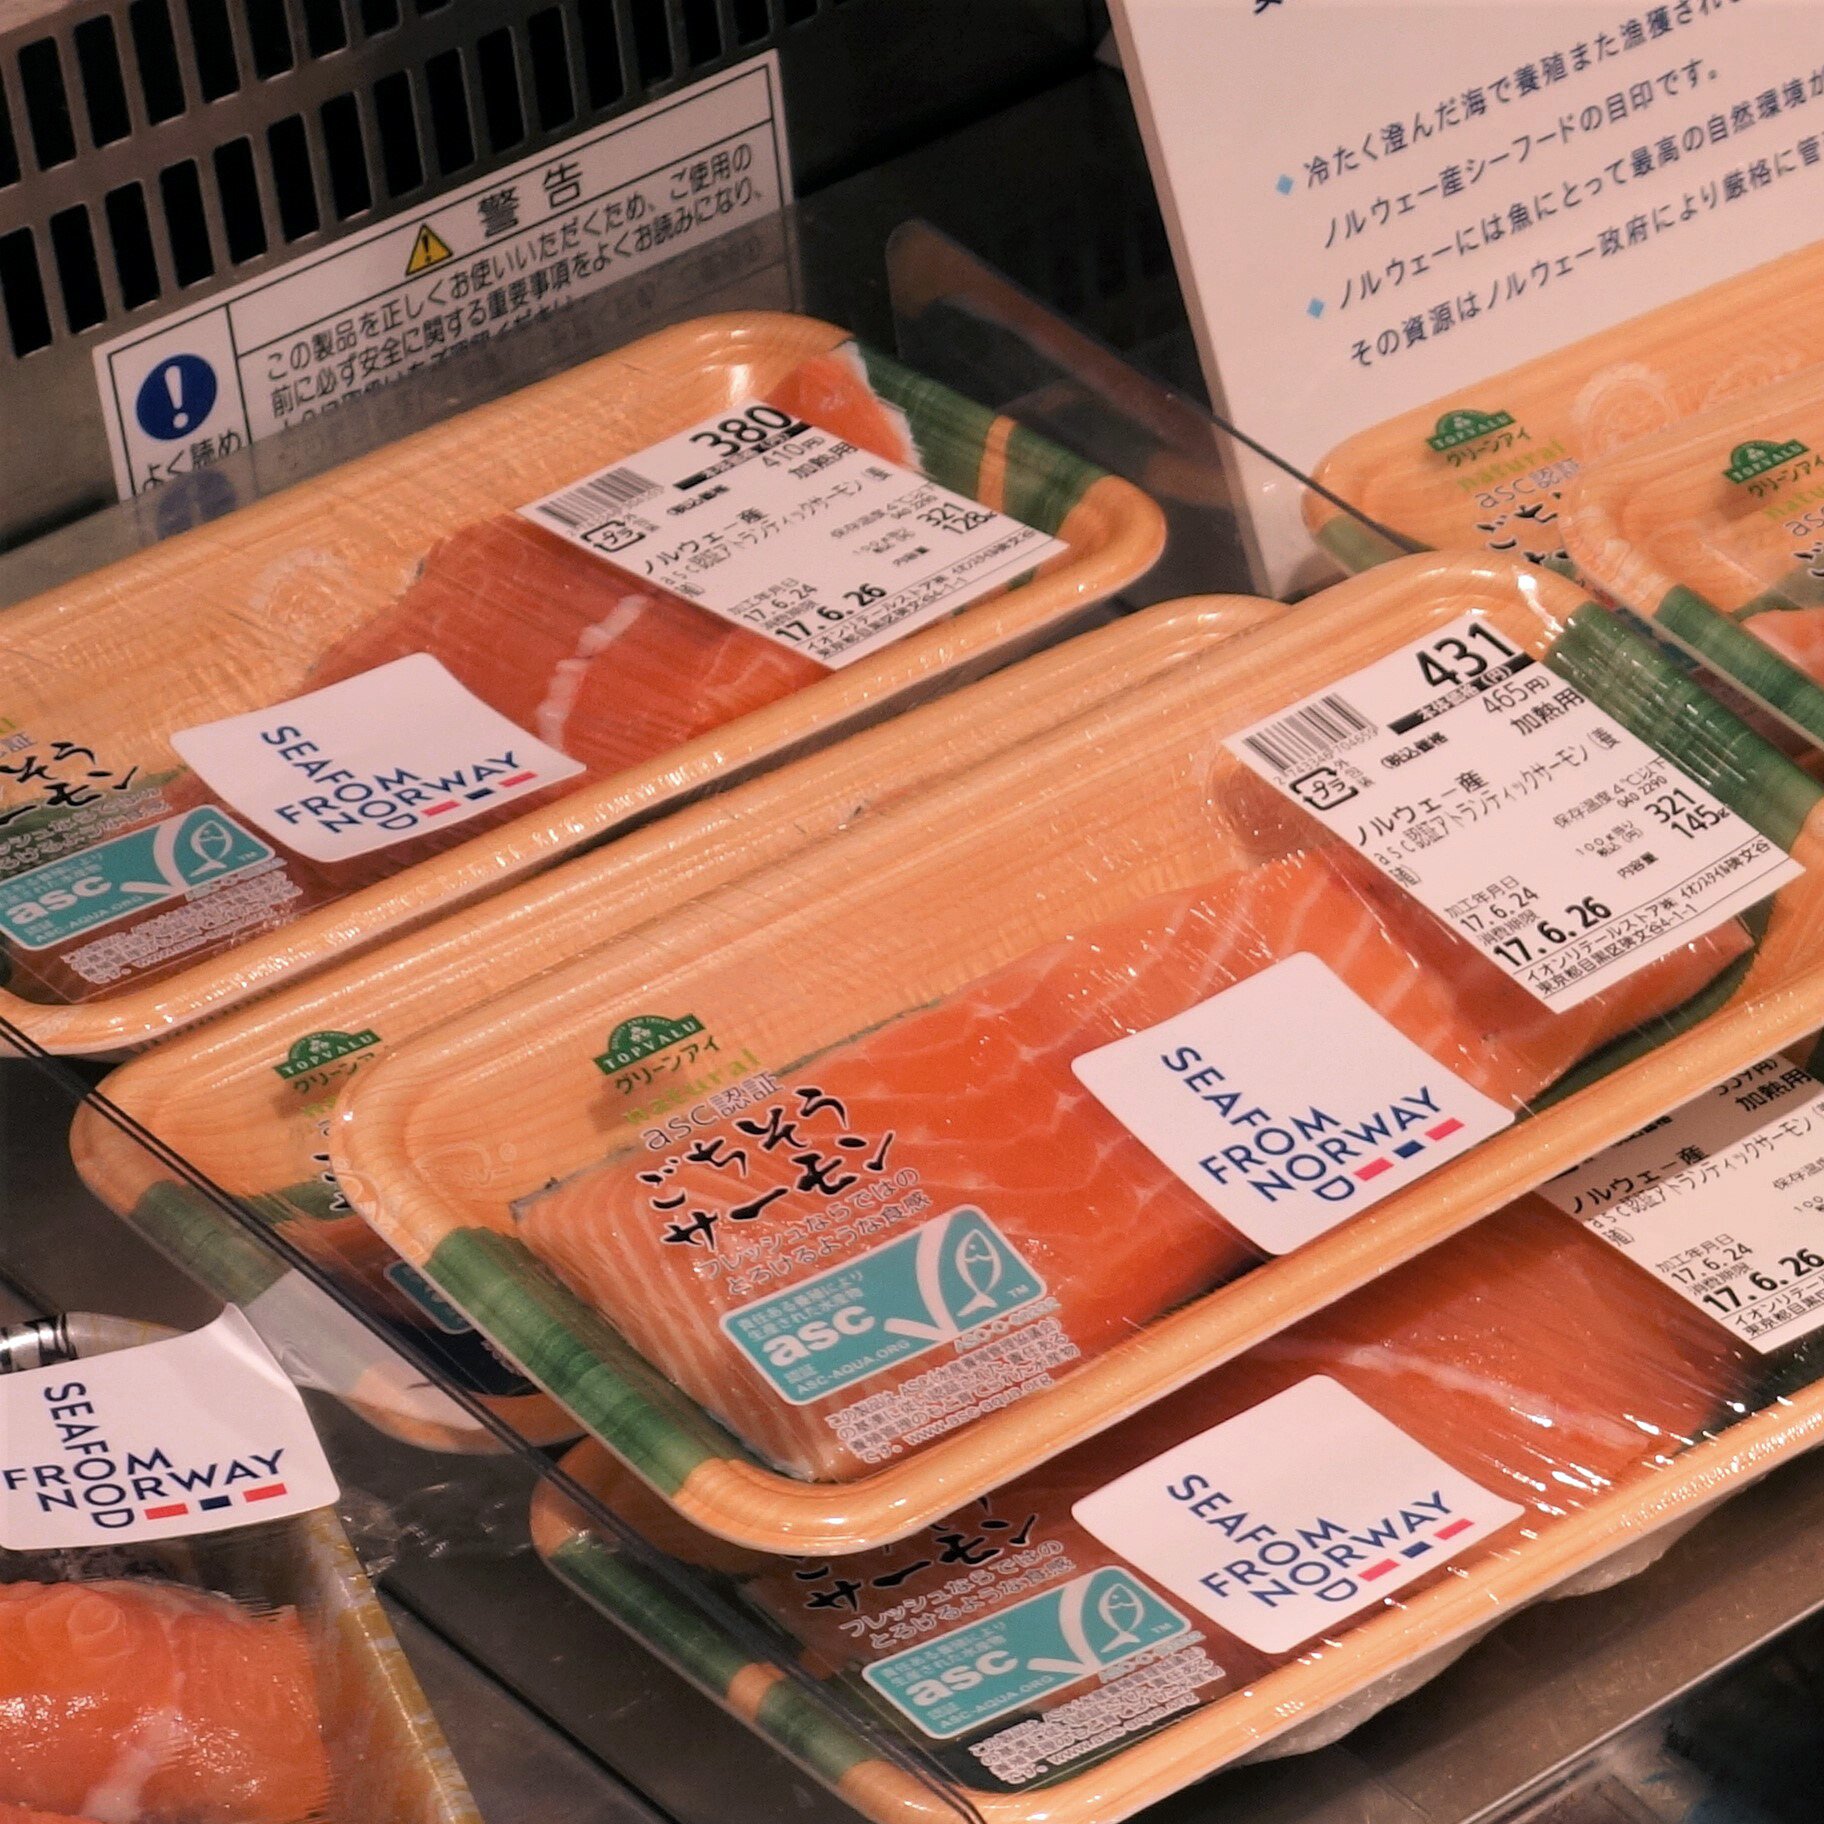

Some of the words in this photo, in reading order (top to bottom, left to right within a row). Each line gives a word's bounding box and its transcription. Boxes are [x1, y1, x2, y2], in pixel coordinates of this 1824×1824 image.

[1324, 60, 1720, 250] ノルウェー産シーフードの目印です。
[480, 163, 584, 237] 警告
[690, 405, 791, 457] 380
[1417, 623, 1515, 687] 431
[1511, 684, 1593, 735] 加熱用
[276, 765, 425, 828] FROM
[322, 751, 524, 838] NORWAY
[1359, 770, 1488, 846] ノルウェー産
[1644, 788, 1703, 823] 321
[602, 1020, 698, 1071] TOPVALU
[614, 1034, 721, 1095] グリーンアイ
[637, 1087, 849, 1210] ごちそう
[1197, 1102, 1336, 1186] FROM
[1250, 1085, 1442, 1206] NORWAY
[662, 1130, 895, 1250] サーモン
[762, 1306, 876, 1368] asc
[3, 1448, 173, 1488] FROM
[35, 1448, 288, 1517] NORWAY
[1198, 1515, 1348, 1601] FROM
[1261, 1491, 1453, 1608] NORWAY
